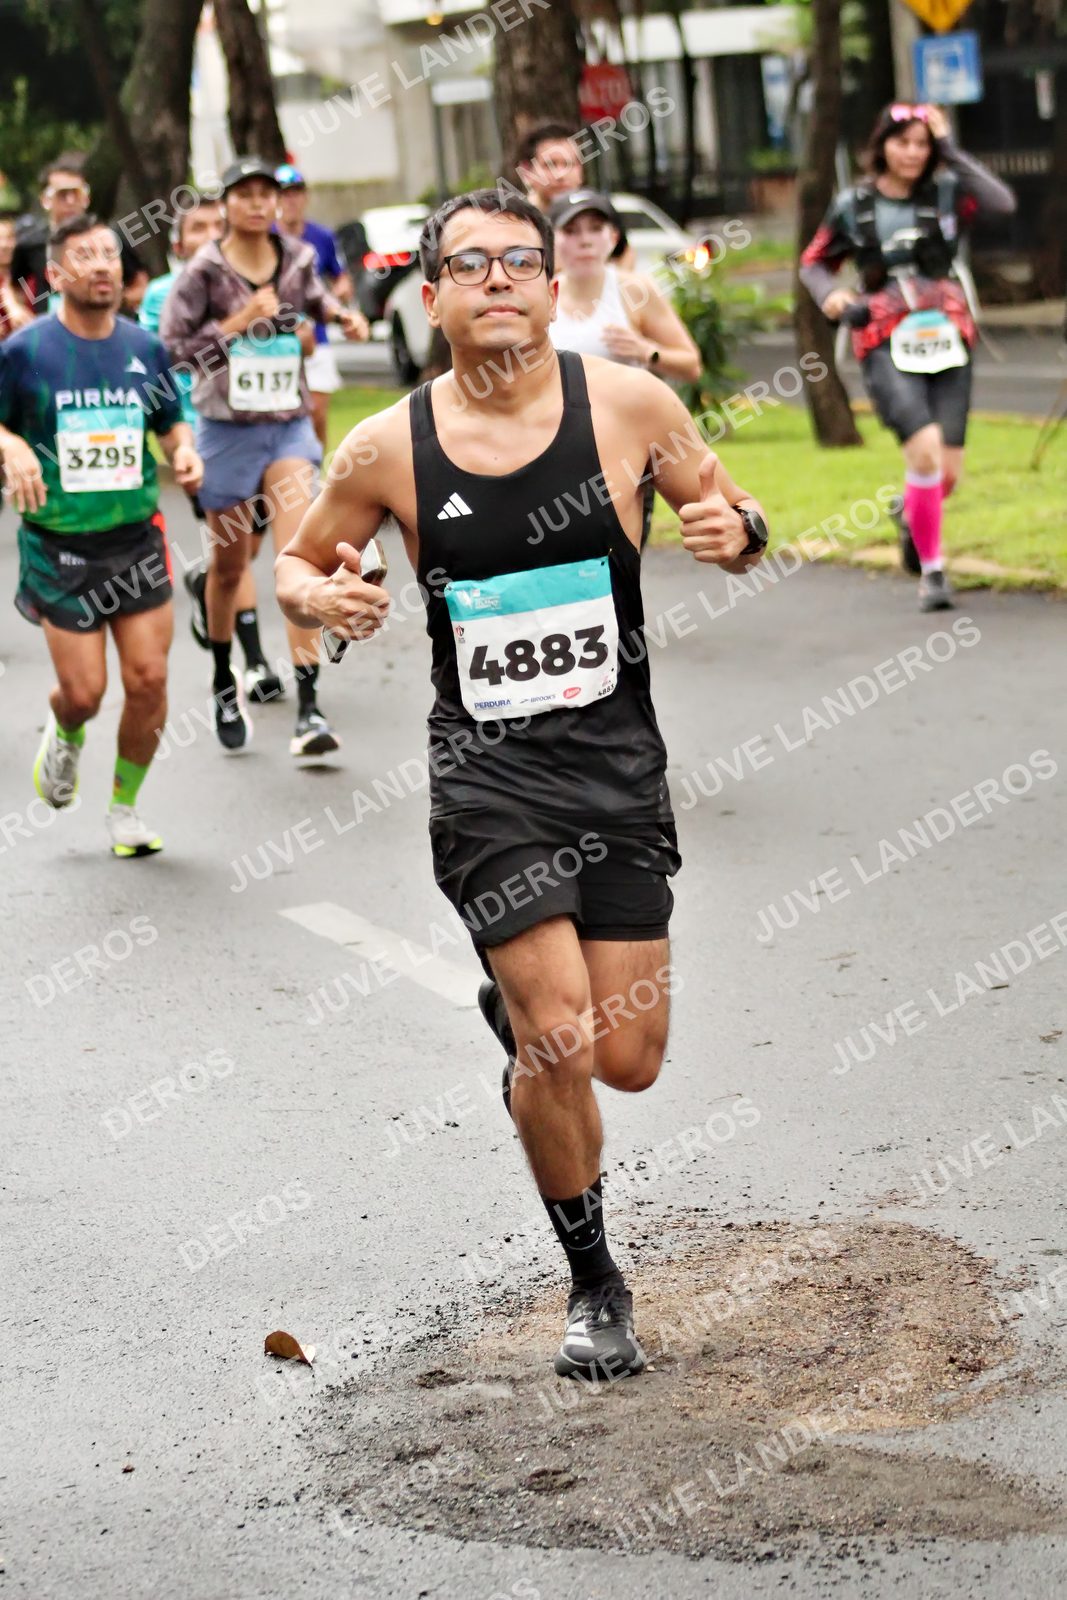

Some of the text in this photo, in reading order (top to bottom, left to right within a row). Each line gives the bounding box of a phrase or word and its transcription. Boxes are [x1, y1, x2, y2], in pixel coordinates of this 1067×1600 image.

[236, 371, 293, 392] 6137
[56, 388, 143, 410] PIRMA
[67, 445, 137, 469] 3295
[469, 624, 609, 686] 4883
[597, 684, 615, 697] 4883
[474, 698, 512, 710] PERDURA
